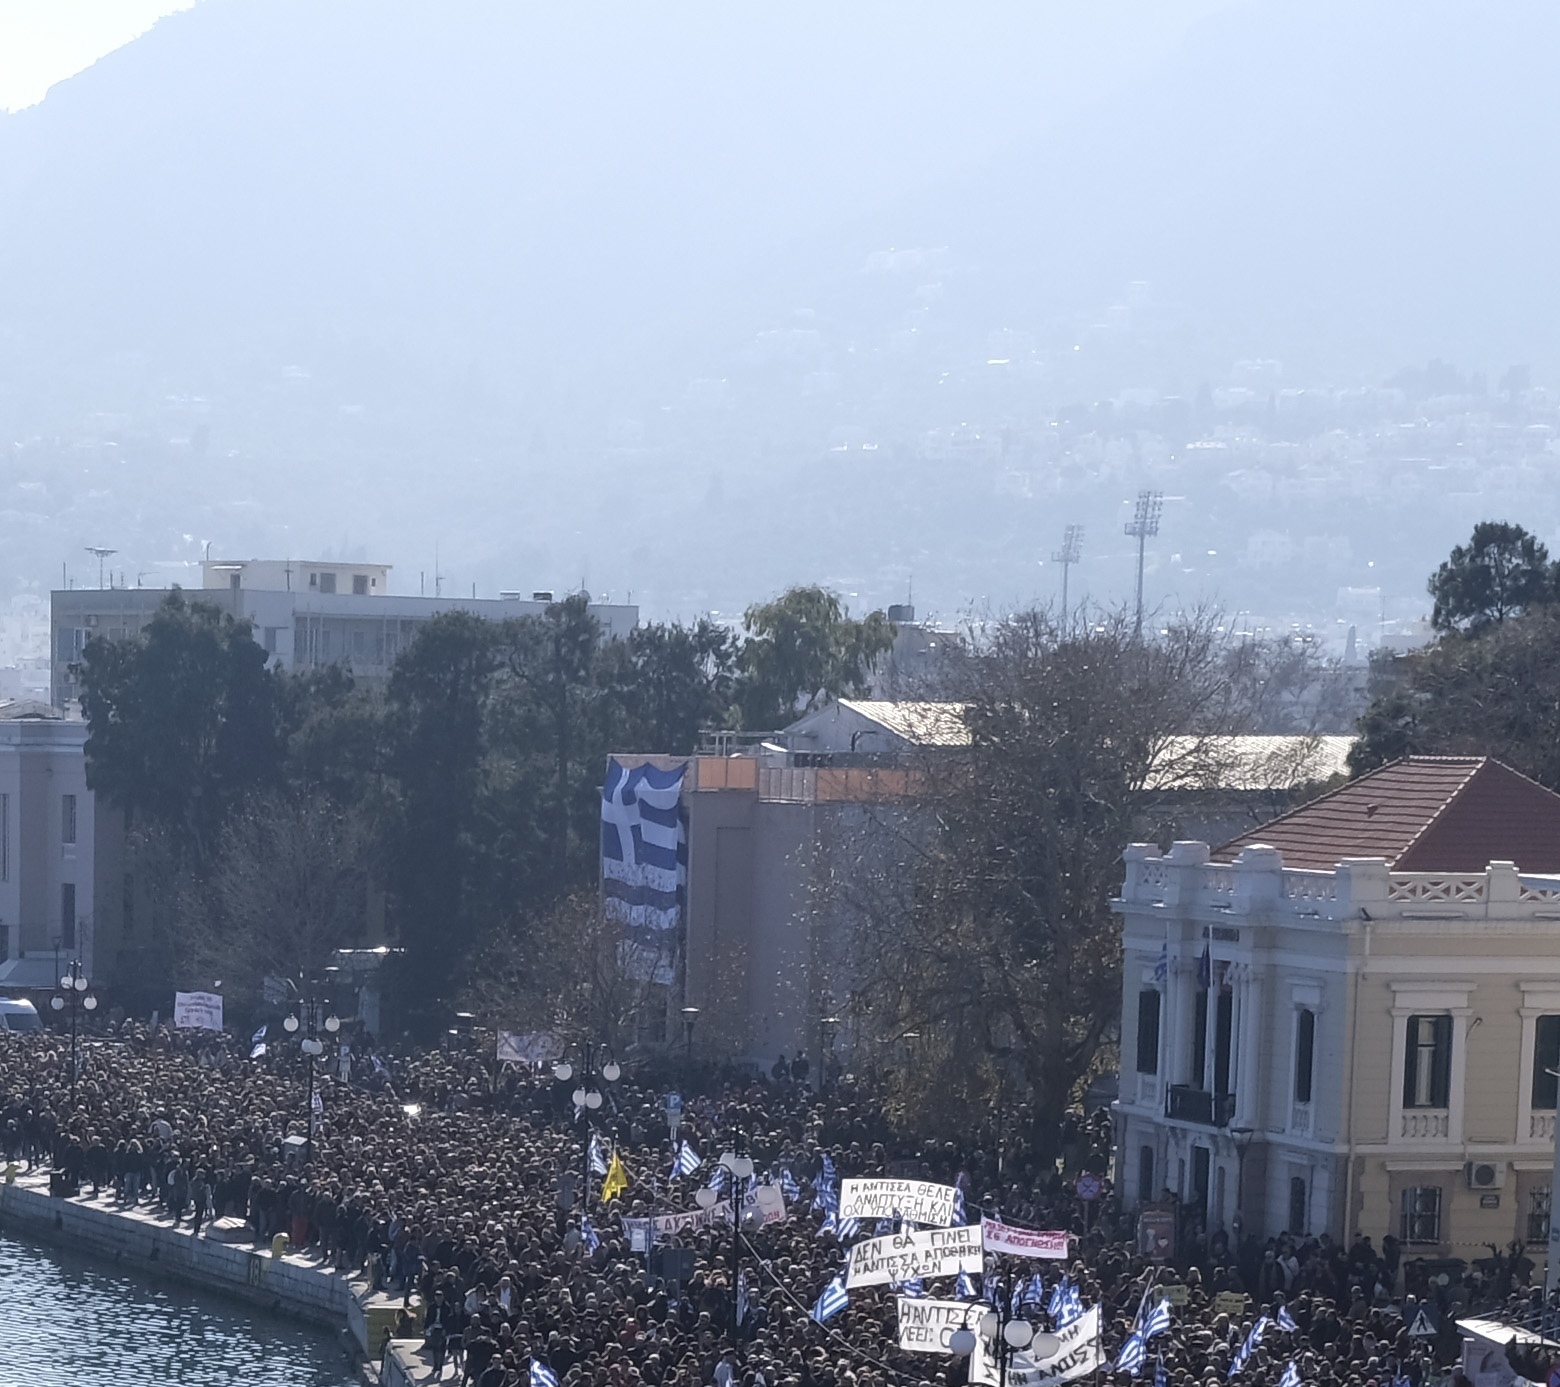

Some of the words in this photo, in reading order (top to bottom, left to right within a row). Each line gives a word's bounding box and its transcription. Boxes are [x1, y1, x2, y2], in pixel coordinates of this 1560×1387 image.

[870, 1206, 948, 1225] ΥΠΟΑΘΜΙΣΗ
[854, 1239, 882, 1264] ΔΕΝ
[893, 1236, 915, 1250] ΘΑ
[863, 1250, 920, 1274] ΑΝΤΙΣΣΑ
